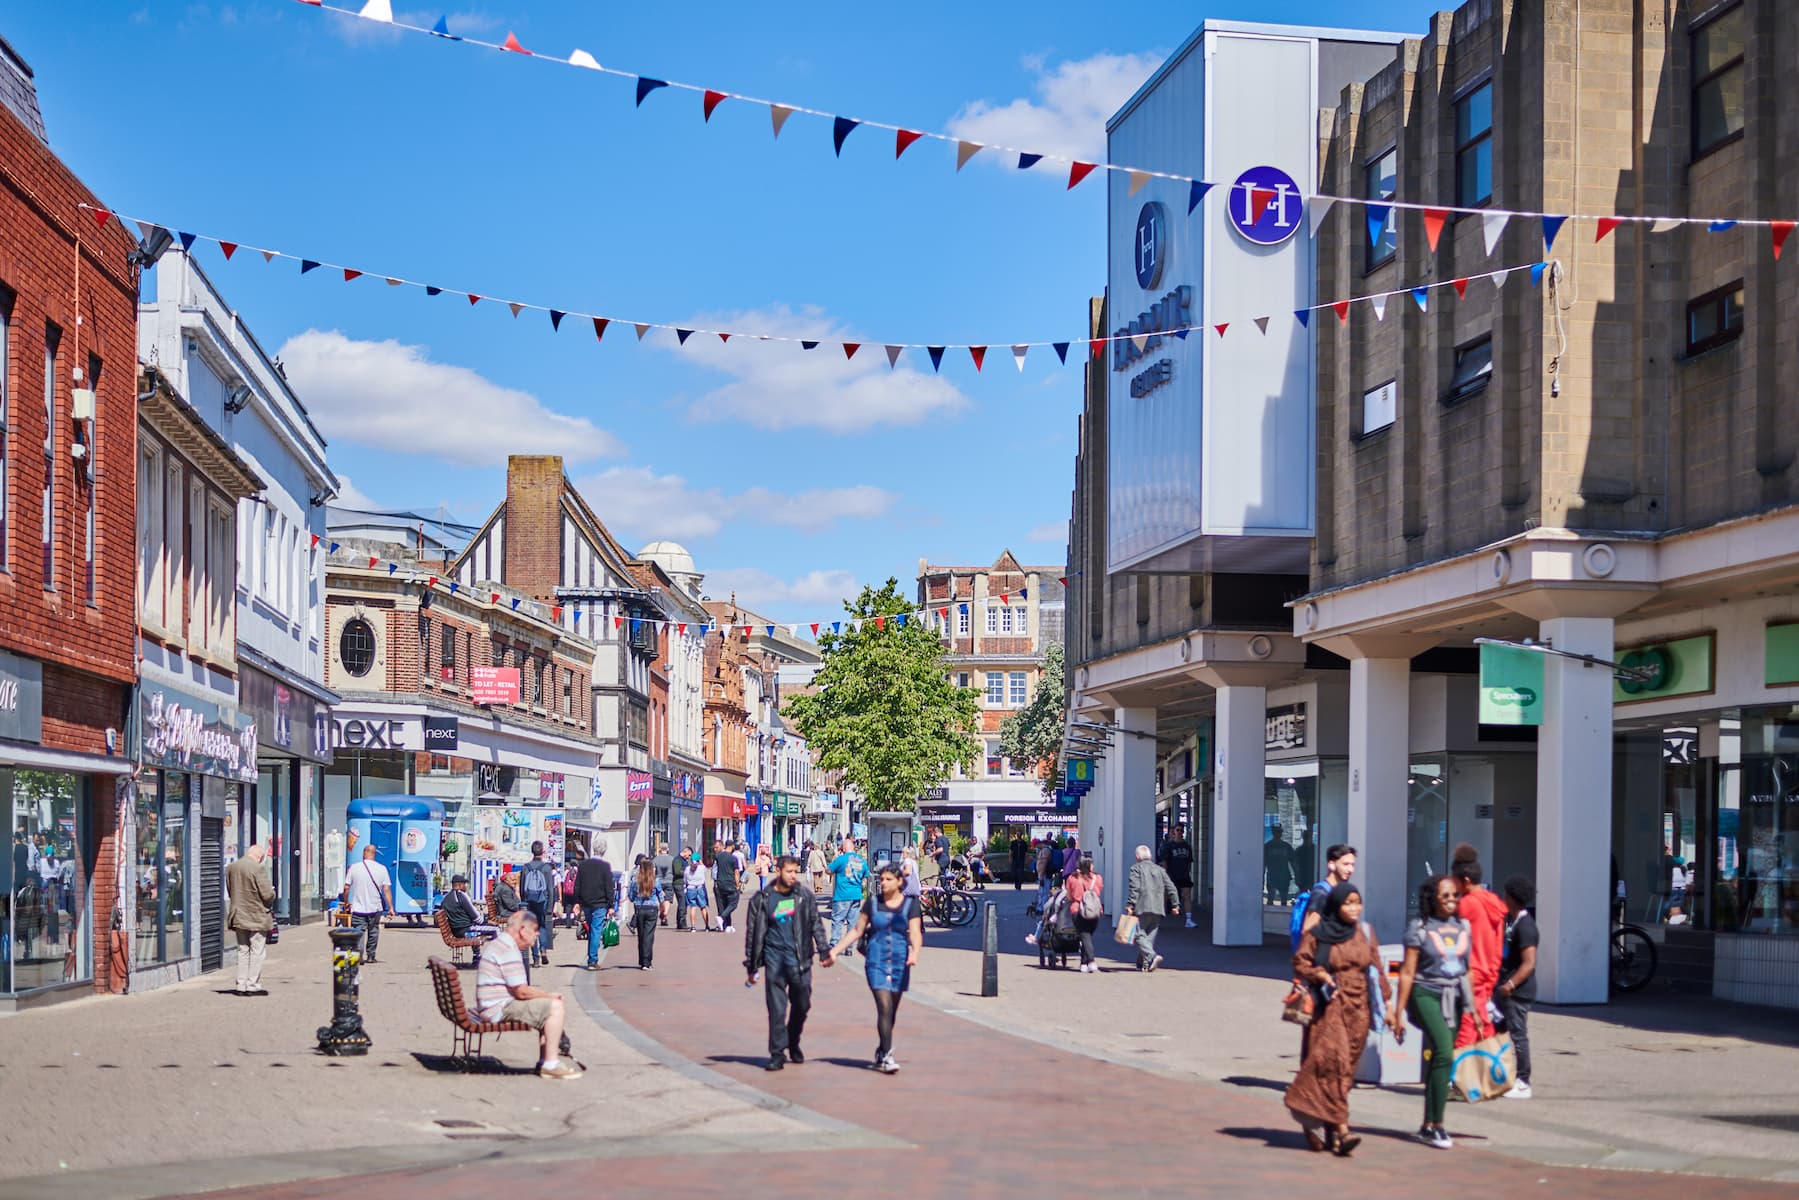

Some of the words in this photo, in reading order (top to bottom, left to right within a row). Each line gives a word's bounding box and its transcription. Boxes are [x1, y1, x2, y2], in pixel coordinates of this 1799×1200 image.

[426, 728, 455, 739] next
[480, 764, 501, 792] next
[1004, 814, 1036, 822] FOREIGN
